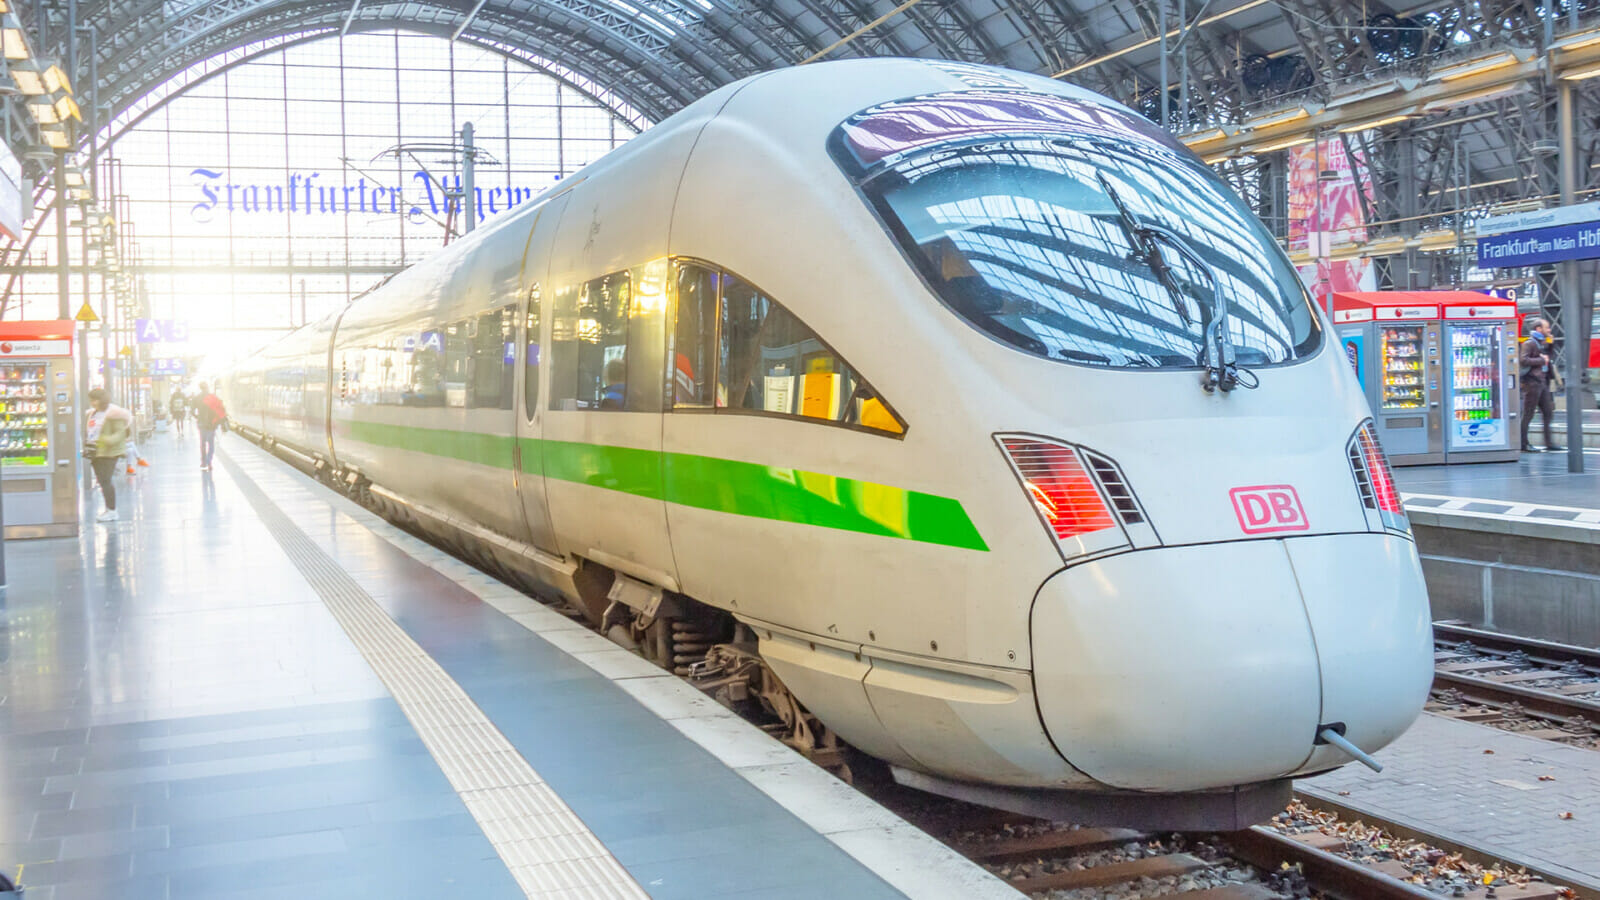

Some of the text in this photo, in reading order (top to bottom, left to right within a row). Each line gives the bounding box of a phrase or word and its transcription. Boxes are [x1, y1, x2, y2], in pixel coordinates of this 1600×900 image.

[189, 168, 401, 224] Frankfurter
[1483, 228, 1600, 259] Frankfurt am Main Hbf
[1506, 289, 1516, 302] 9
[143, 319, 160, 339] A
[1240, 492, 1299, 526] DB
